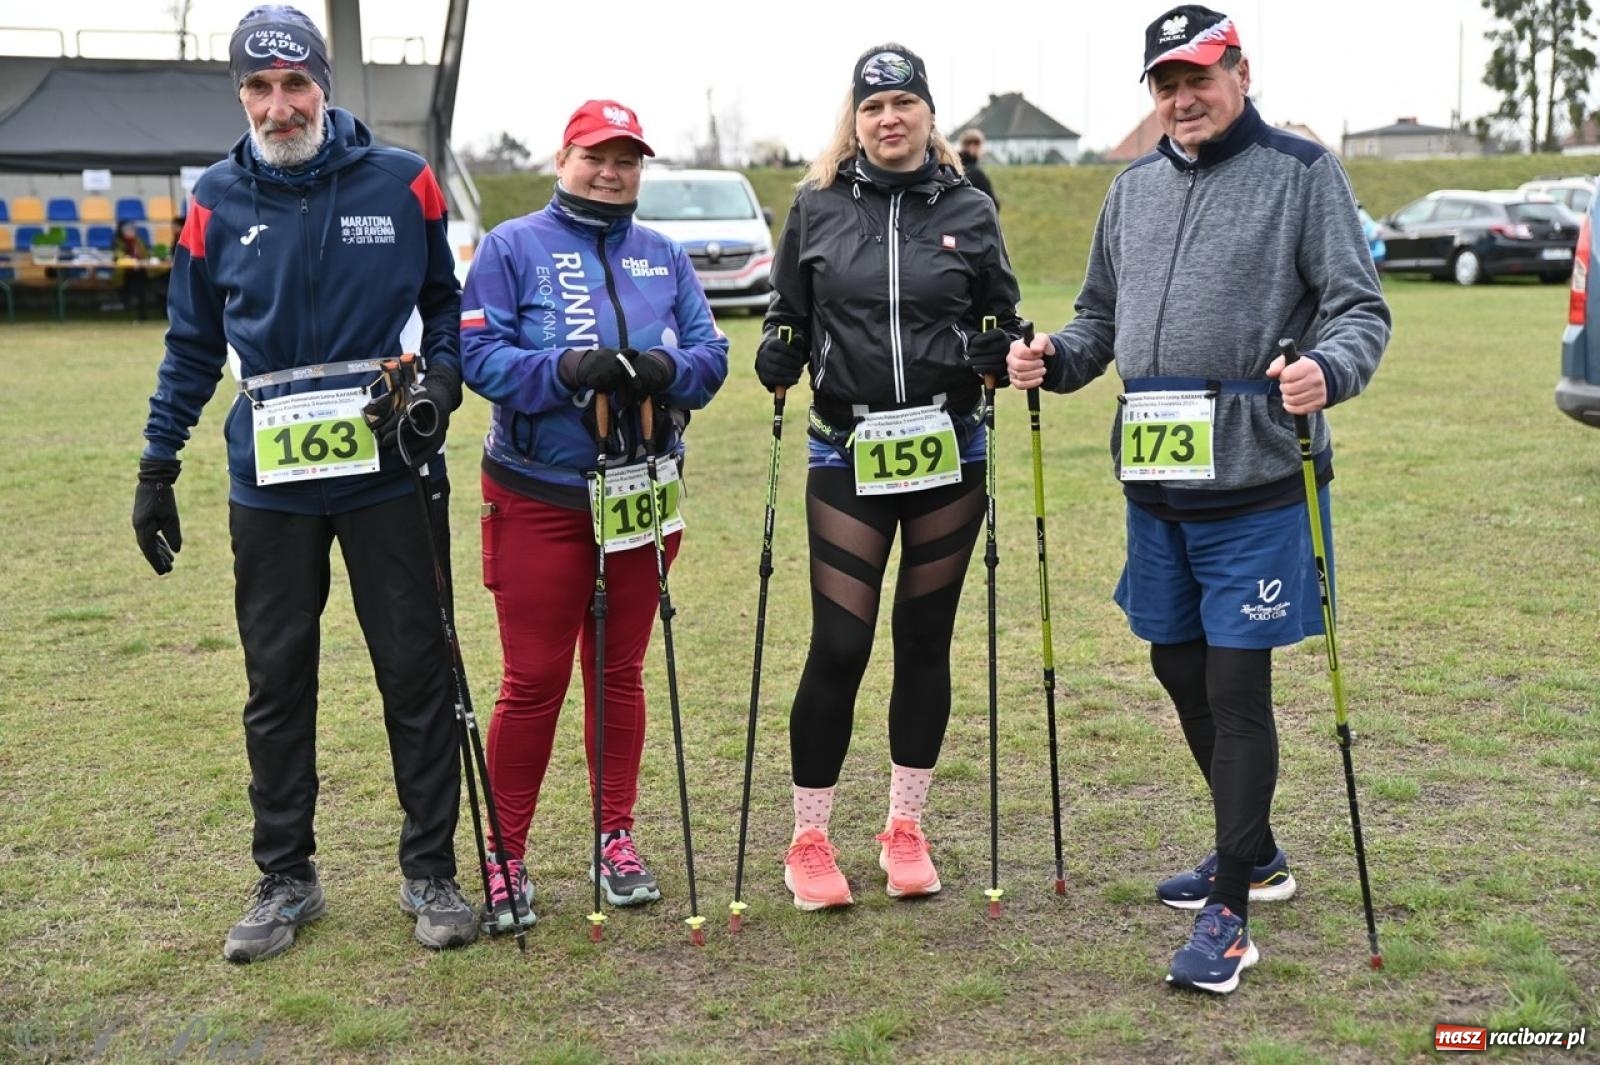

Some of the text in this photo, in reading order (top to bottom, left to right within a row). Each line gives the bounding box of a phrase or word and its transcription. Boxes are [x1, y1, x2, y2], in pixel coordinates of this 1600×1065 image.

[255, 30, 292, 41] ULTRA
[258, 39, 304, 54] ZADEK
[1159, 34, 1186, 43] POLSKA
[340, 215, 392, 227] MARATONA
[364, 226, 396, 236] RAVENNA
[535, 265, 556, 341] EKO-OKNA
[272, 420, 359, 466] 163
[1131, 424, 1195, 463] 173
[869, 436, 944, 479] 159
[610, 487, 669, 535] 181
[1257, 578, 1282, 603] 10
